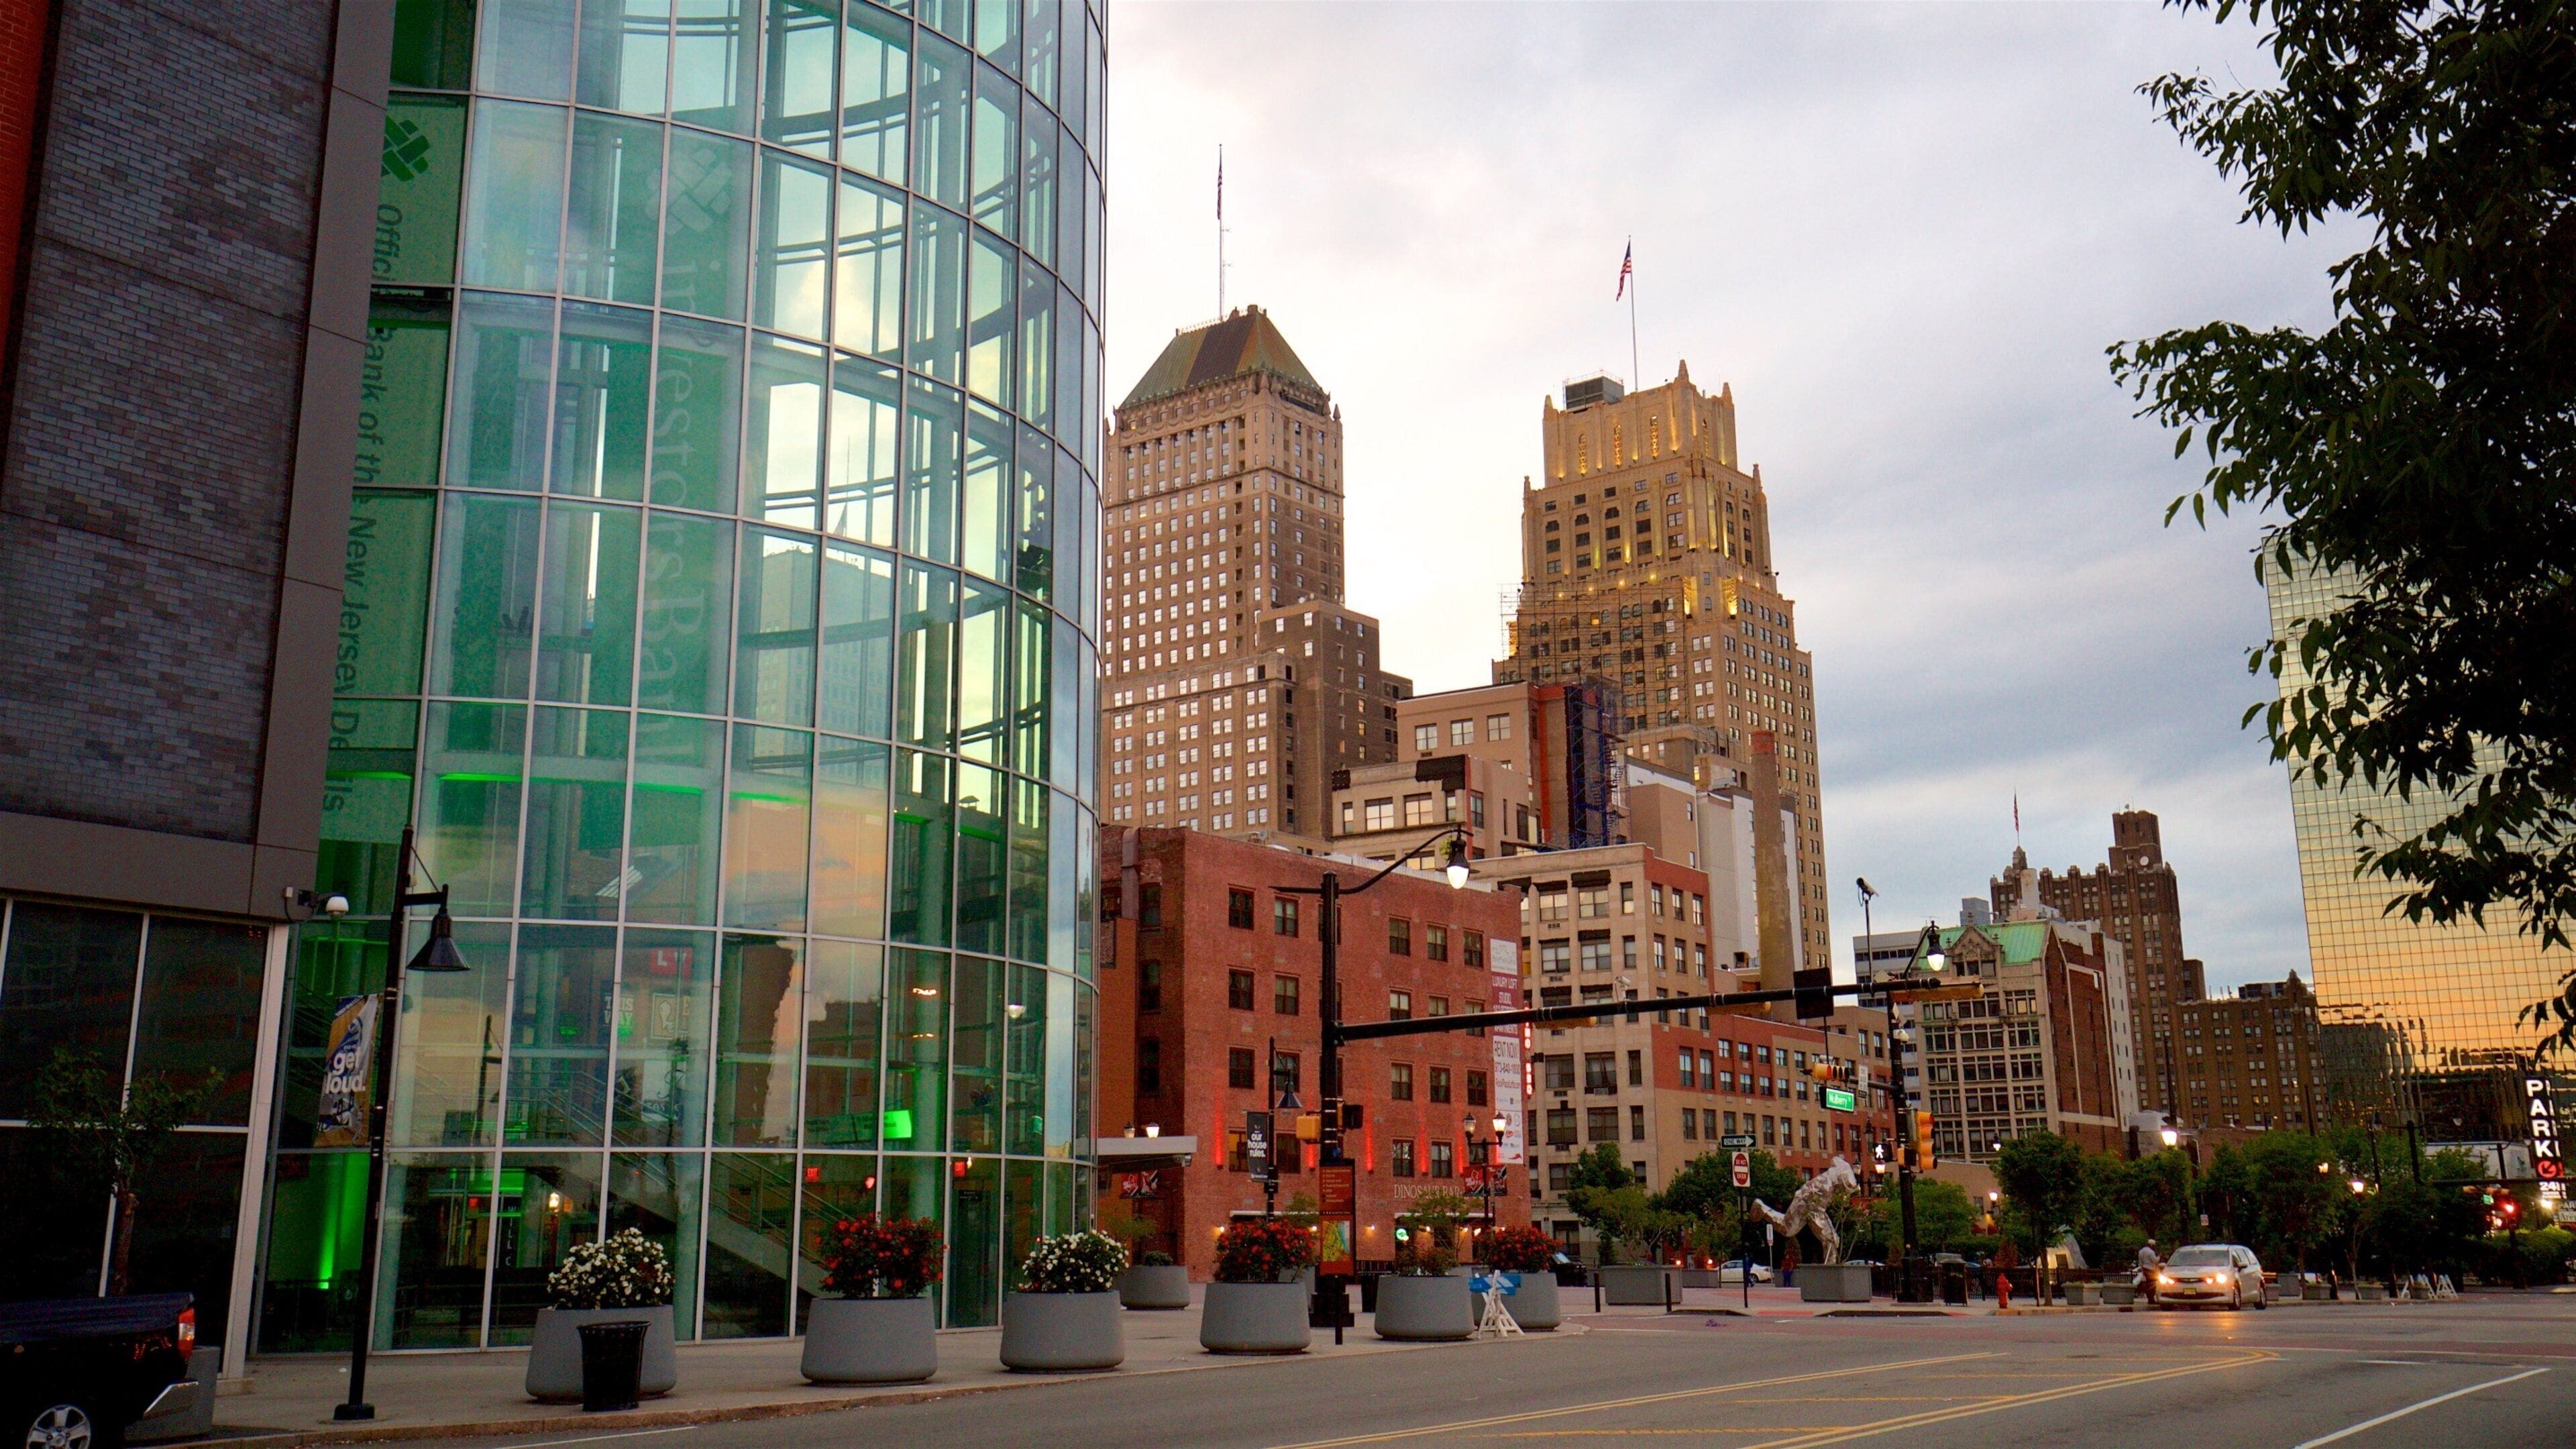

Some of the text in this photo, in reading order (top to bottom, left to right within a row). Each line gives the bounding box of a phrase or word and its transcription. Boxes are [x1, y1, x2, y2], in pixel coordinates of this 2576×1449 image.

[372, 204, 402, 283] Offici
[357, 412, 384, 445] of
[343, 515, 376, 588] New
[323, 712, 360, 812] Deils
[332, 1049, 360, 1076] get
[1829, 1092, 1847, 1108] Mulberry
[2526, 1079, 2554, 1158] PARK
[1248, 1139, 1267, 1149] house
[1394, 1183, 1440, 1199] DINOSAUR
